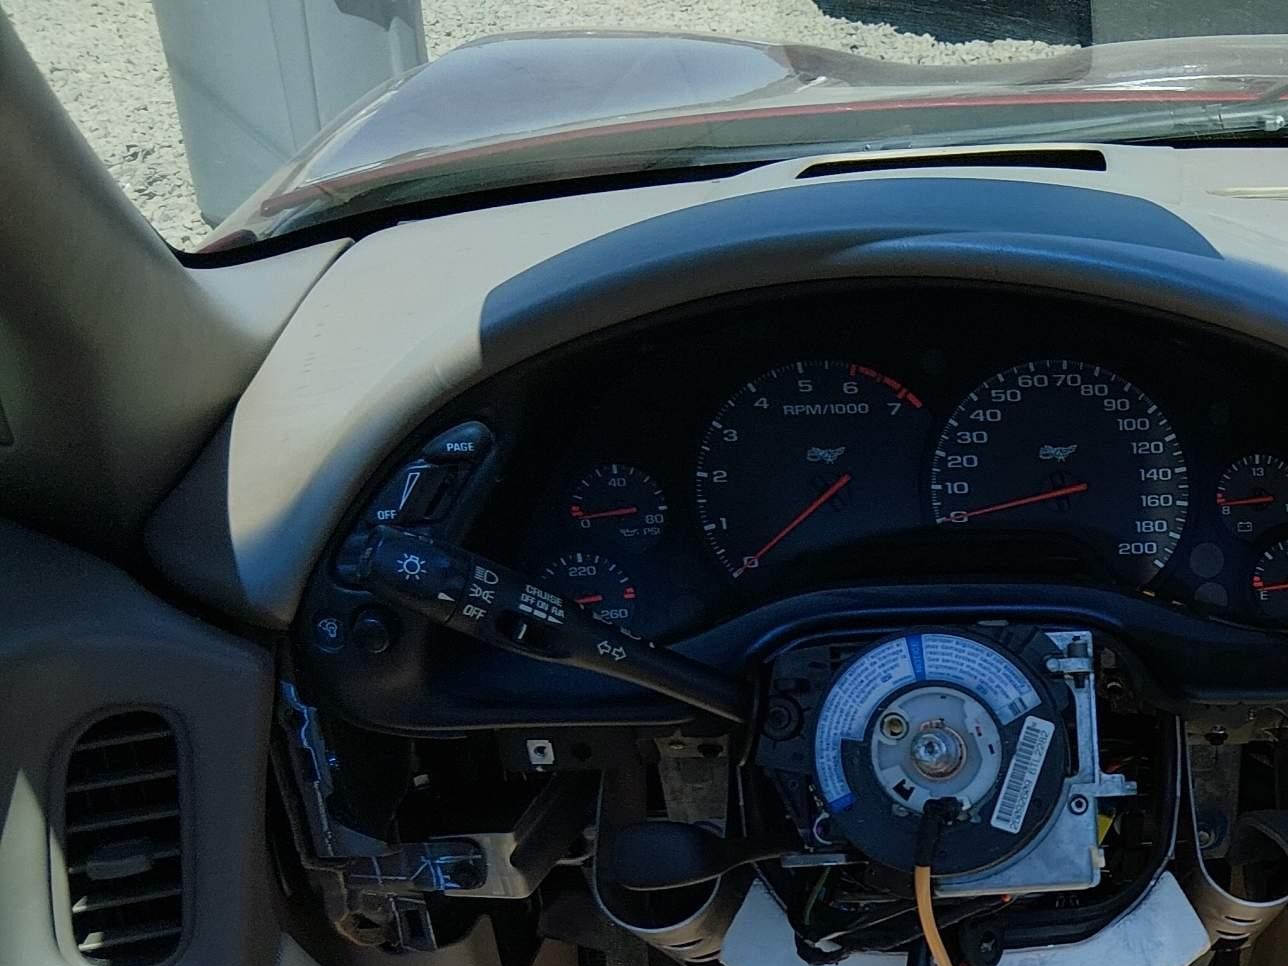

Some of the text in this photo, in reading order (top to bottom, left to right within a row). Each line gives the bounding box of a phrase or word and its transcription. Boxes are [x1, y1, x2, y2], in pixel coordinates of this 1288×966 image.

[798, 380, 813, 392] 5
[1018, 375, 1049, 387] 60
[1053, 374, 1081, 386] 70
[843, 382, 858, 394] 6
[1081, 385, 1108, 396] 80
[991, 389, 1021, 402] 50
[754, 398, 769, 409] 4
[783, 403, 869, 416] RPM/1000
[888, 403, 901, 415] 7
[1104, 399, 1130, 411] 90
[969, 409, 1001, 422] 40
[1117, 418, 1149, 431] 100
[723, 430, 738, 441] 3
[957, 432, 988, 443] 30
[446, 442, 476, 452] PAGE
[1131, 442, 1164, 454] 120
[947, 456, 978, 468] 20
[712, 470, 728, 482] 2
[1139, 468, 1172, 481] 140
[1252, 467, 1264, 477] 13
[608, 477, 626, 488] 40
[946, 482, 969, 494] 10
[1140, 494, 1173, 507] 160
[377, 510, 397, 520] OFF
[1222, 506, 1231, 515] 8
[580, 520, 591, 528] 0
[645, 514, 664, 524] 80
[719, 518, 727, 530] 1
[1135, 520, 1168, 532] 180
[1118, 542, 1157, 555] 200
[569, 565, 597, 577] 220
[526, 584, 562, 607] CRUISE
[1260, 590, 1269, 600] E
[462, 604, 487, 621] OFF
[601, 608, 628, 620] 260
